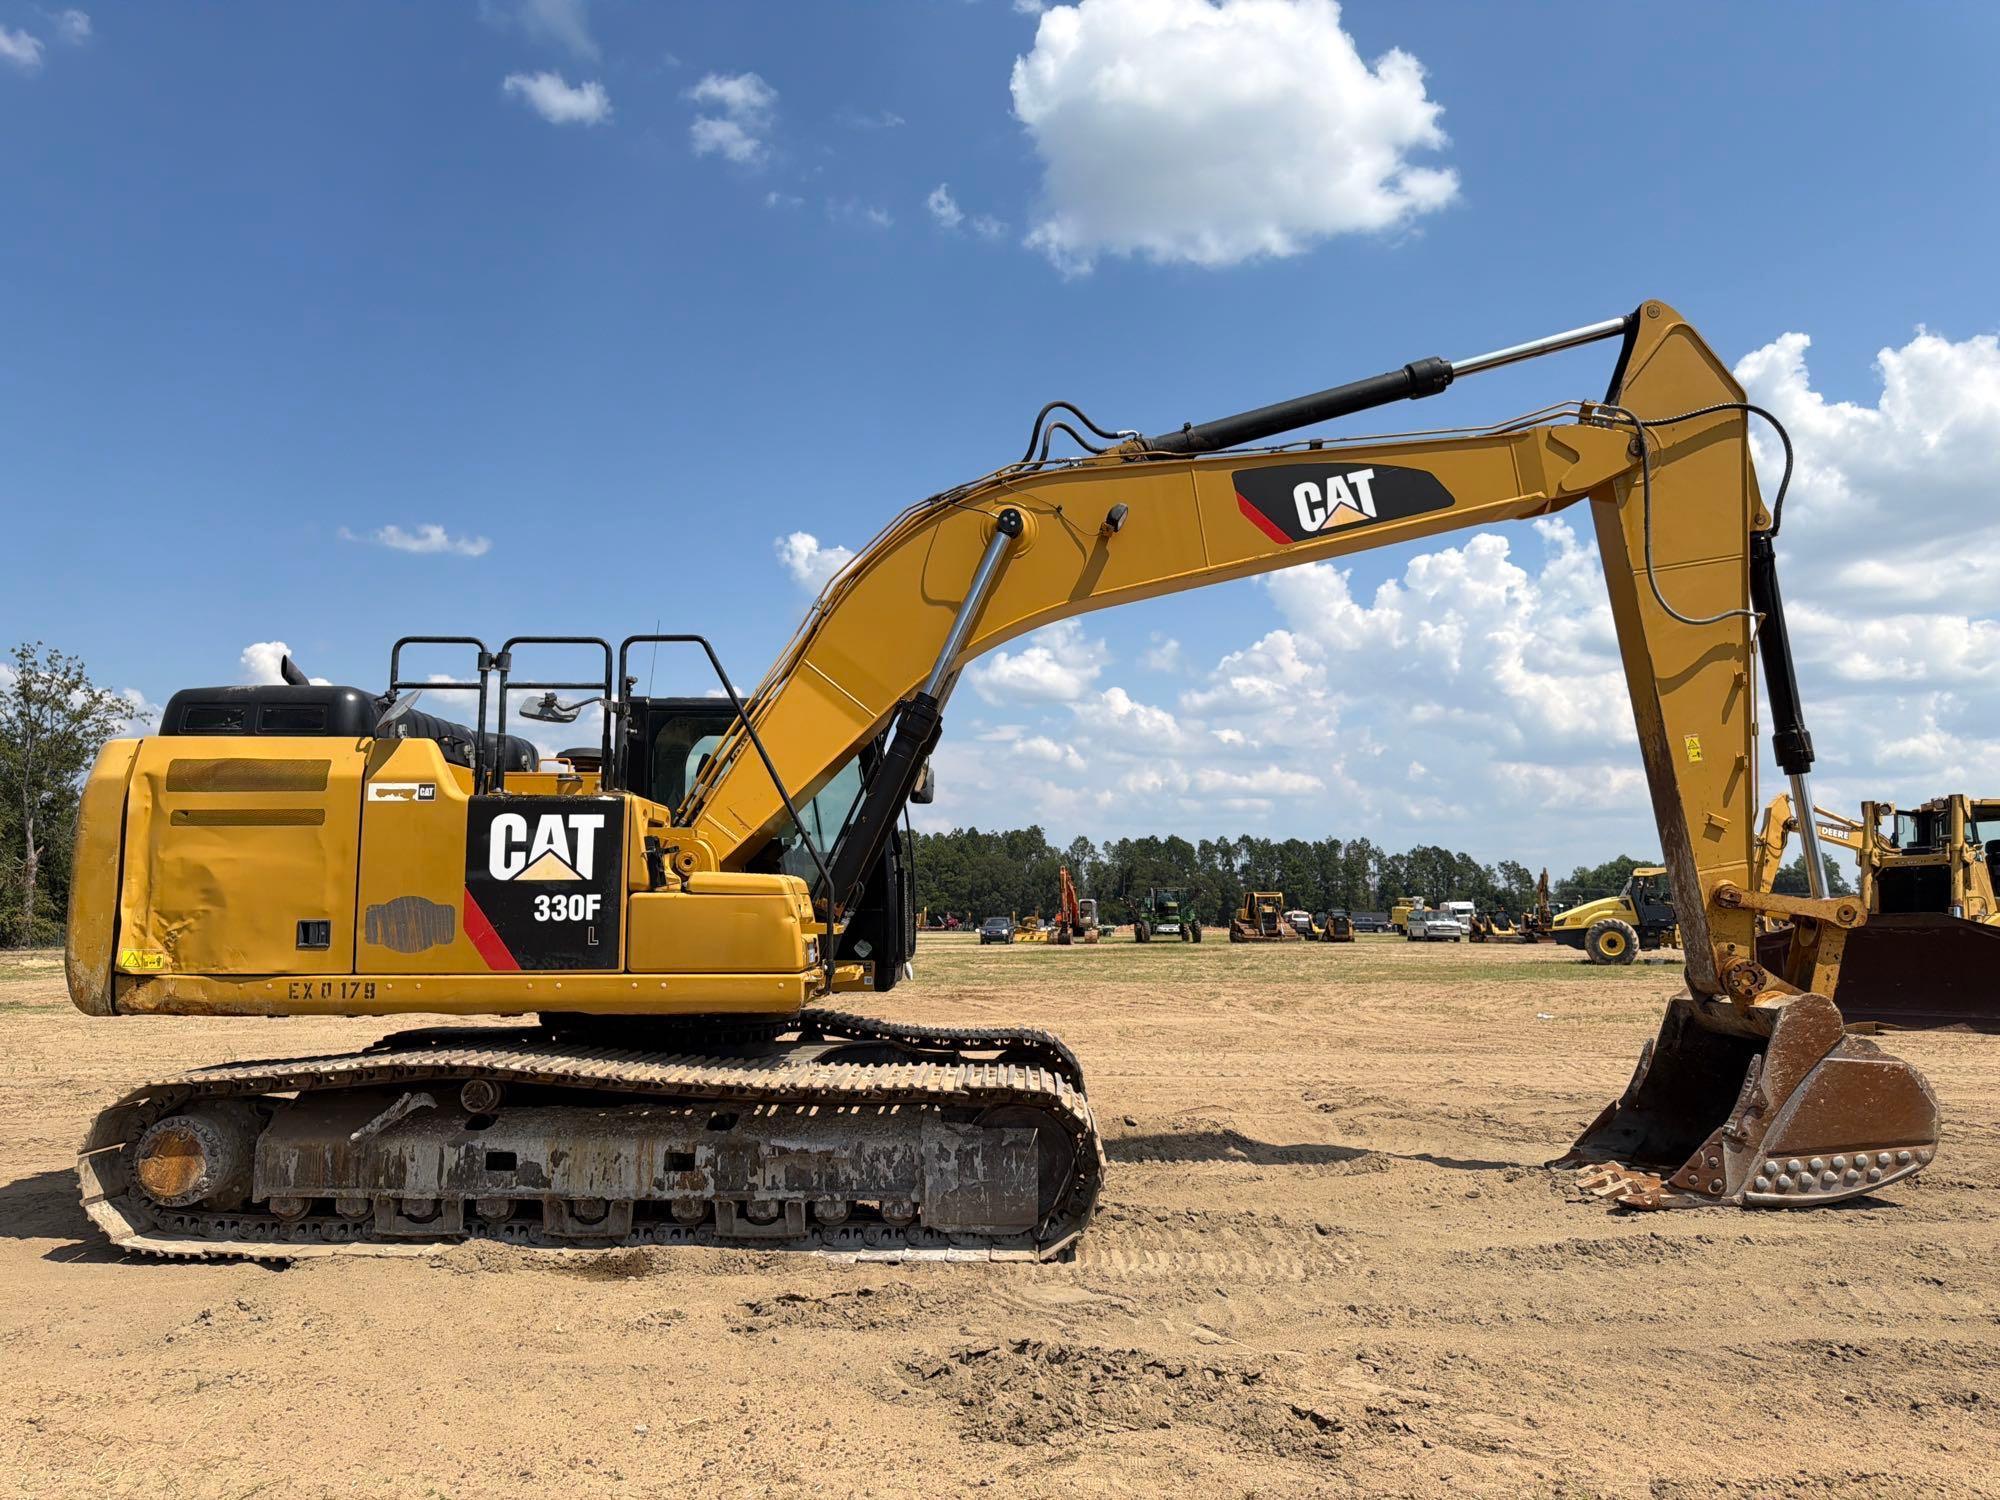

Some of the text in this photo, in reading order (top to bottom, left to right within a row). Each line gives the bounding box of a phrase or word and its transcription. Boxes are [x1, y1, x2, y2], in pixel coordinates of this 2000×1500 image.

[1293, 468, 1377, 532] CAT
[419, 787, 434, 796] CAT
[1821, 826, 1849, 839] DEERE
[489, 813, 605, 880] CAT
[534, 894, 601, 921] 330F
[587, 926, 599, 945] L
